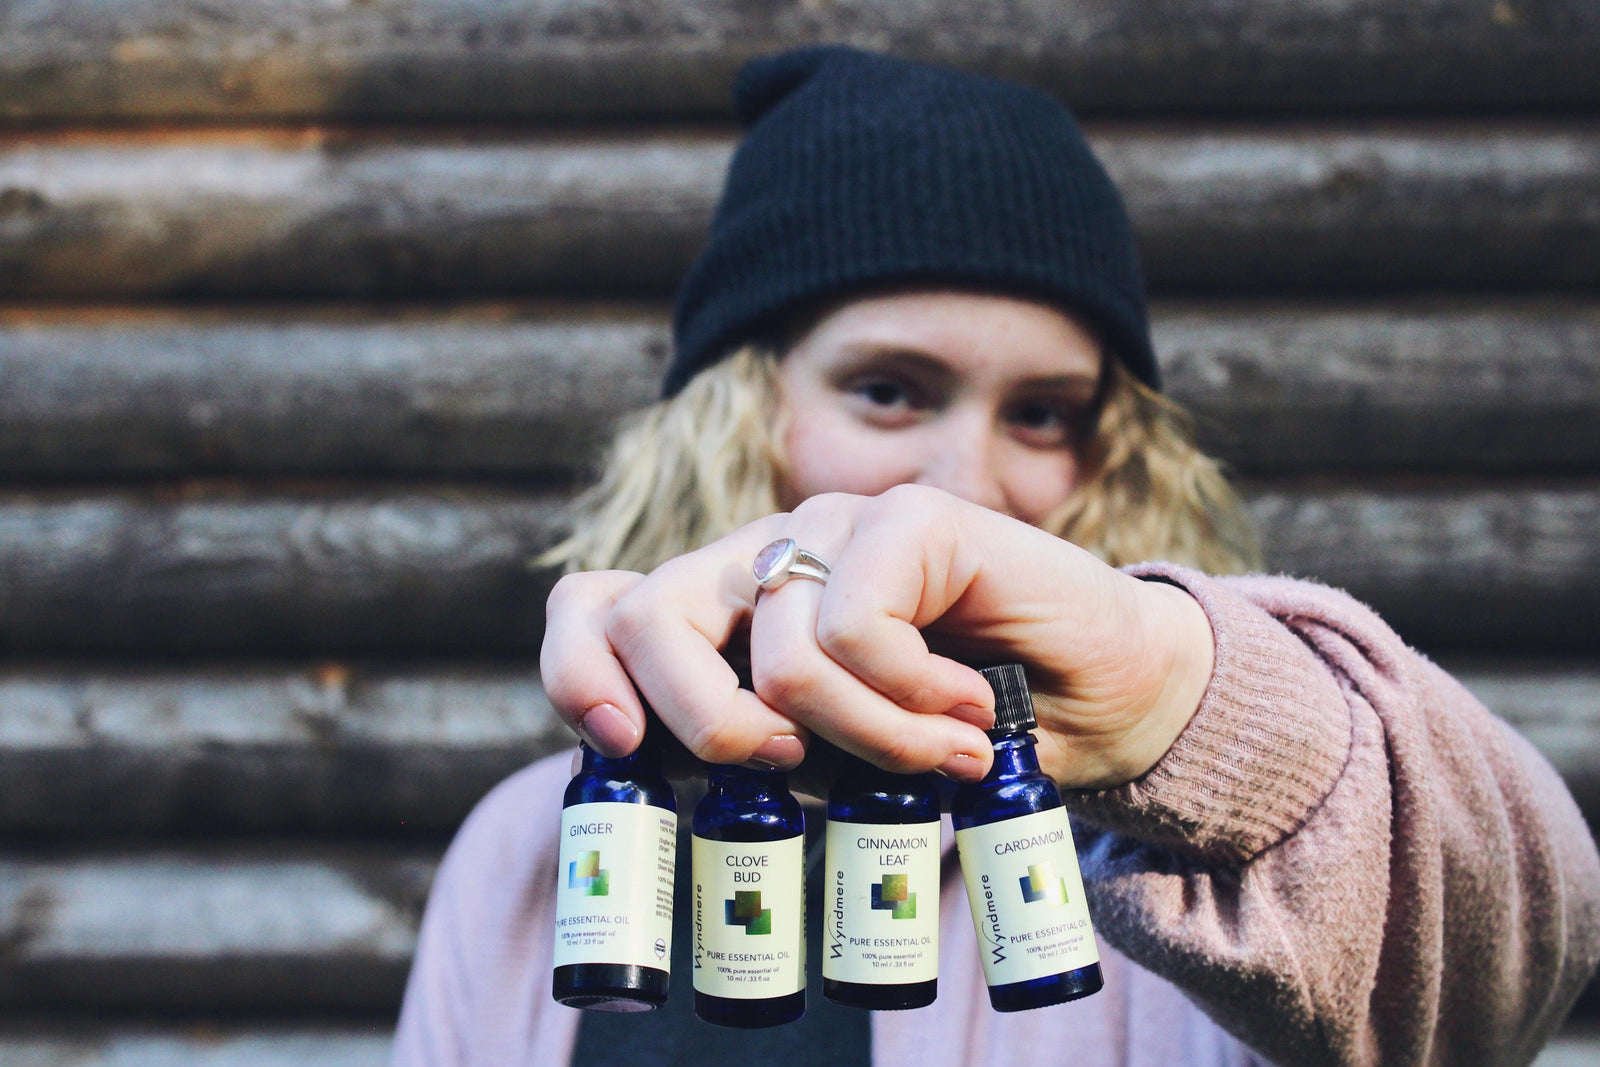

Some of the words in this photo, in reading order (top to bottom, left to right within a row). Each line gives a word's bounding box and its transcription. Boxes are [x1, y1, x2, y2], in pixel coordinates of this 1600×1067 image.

[570, 823, 613, 837] GINGER
[857, 837, 928, 849] CINNAMON
[994, 830, 1065, 856] CARDAMOM
[726, 855, 769, 867] CLOVE
[879, 855, 910, 866] LEAF
[734, 871, 761, 883] BUD
[569, 915, 611, 925] ESSENTIAL
[614, 916, 630, 924] OIL
[827, 870, 846, 959] Wyndmere
[981, 874, 1007, 965] Wyndmere
[694, 884, 705, 969] Wyndmere
[1010, 932, 1033, 943] PURE
[1035, 922, 1078, 939] ESSENTIAL
[1079, 919, 1087, 928] OIL
[849, 937, 871, 946] PURE
[874, 938, 919, 946] ESSENTIAL
[921, 936, 931, 944] OIL
[1026, 946, 1042, 954] 100%
[1043, 943, 1056, 951] pure
[707, 950, 725, 960] PURE
[728, 953, 774, 961] ESSENTIAL
[777, 951, 789, 959] OIL
